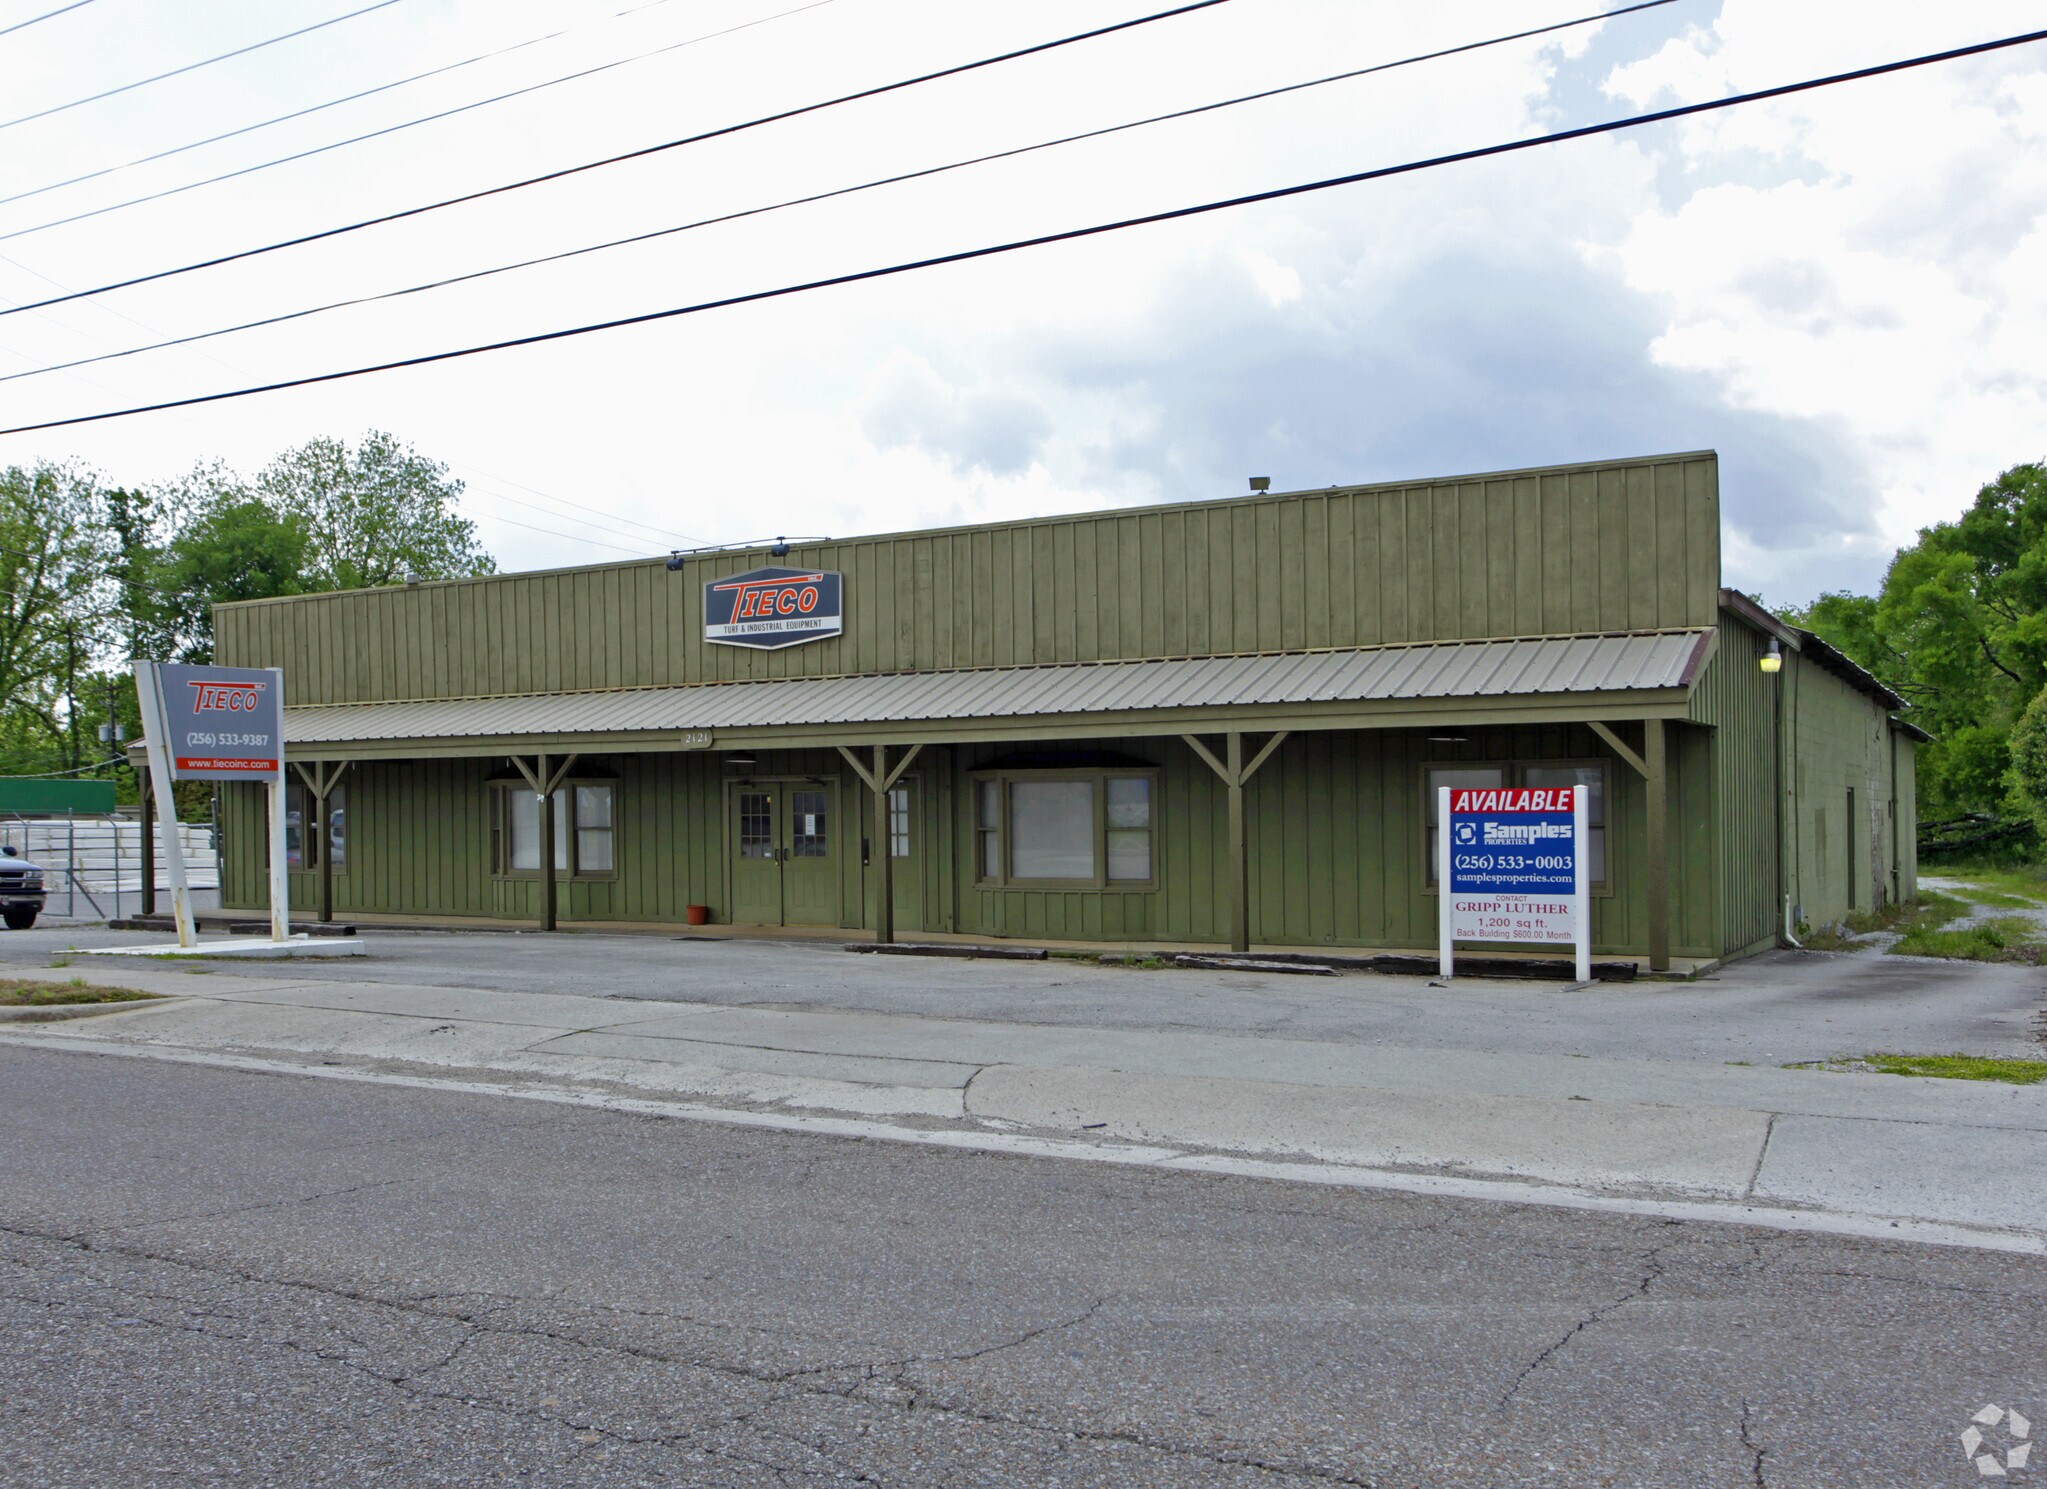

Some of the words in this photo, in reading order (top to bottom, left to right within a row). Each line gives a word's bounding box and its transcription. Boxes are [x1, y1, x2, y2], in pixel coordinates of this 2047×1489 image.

[713, 573, 824, 624] TIECO
[724, 626, 739, 634] TURF
[741, 625, 746, 633] &
[747, 623, 783, 632] INDUSTRIAL
[786, 619, 822, 630] EQUIPMENT
[187, 681, 266, 714] TIECO
[187, 732, 216, 748] (256)
[219, 734, 269, 746] 533-9387
[685, 733, 707, 743] 2121
[188, 760, 270, 769] www.tiecoinc.com
[1455, 790, 1571, 812] AVAILABLE
[1483, 821, 1572, 845] Samples
[1455, 854, 1494, 870] (256)
[1497, 856, 1573, 869] 533-0003
[1456, 873, 1573, 885] samplesproperties.com
[1455, 902, 1501, 912] GRIPP
[1506, 903, 1569, 914] LUTHER
[1478, 918, 1511, 928] 1,200
[1516, 920, 1531, 929] sq
[1535, 919, 1548, 928] ft.
[1456, 929, 1476, 937] Back
[1479, 930, 1510, 939] Building
[1513, 931, 1543, 939] $600.00
[1547, 931, 1572, 940] Month
